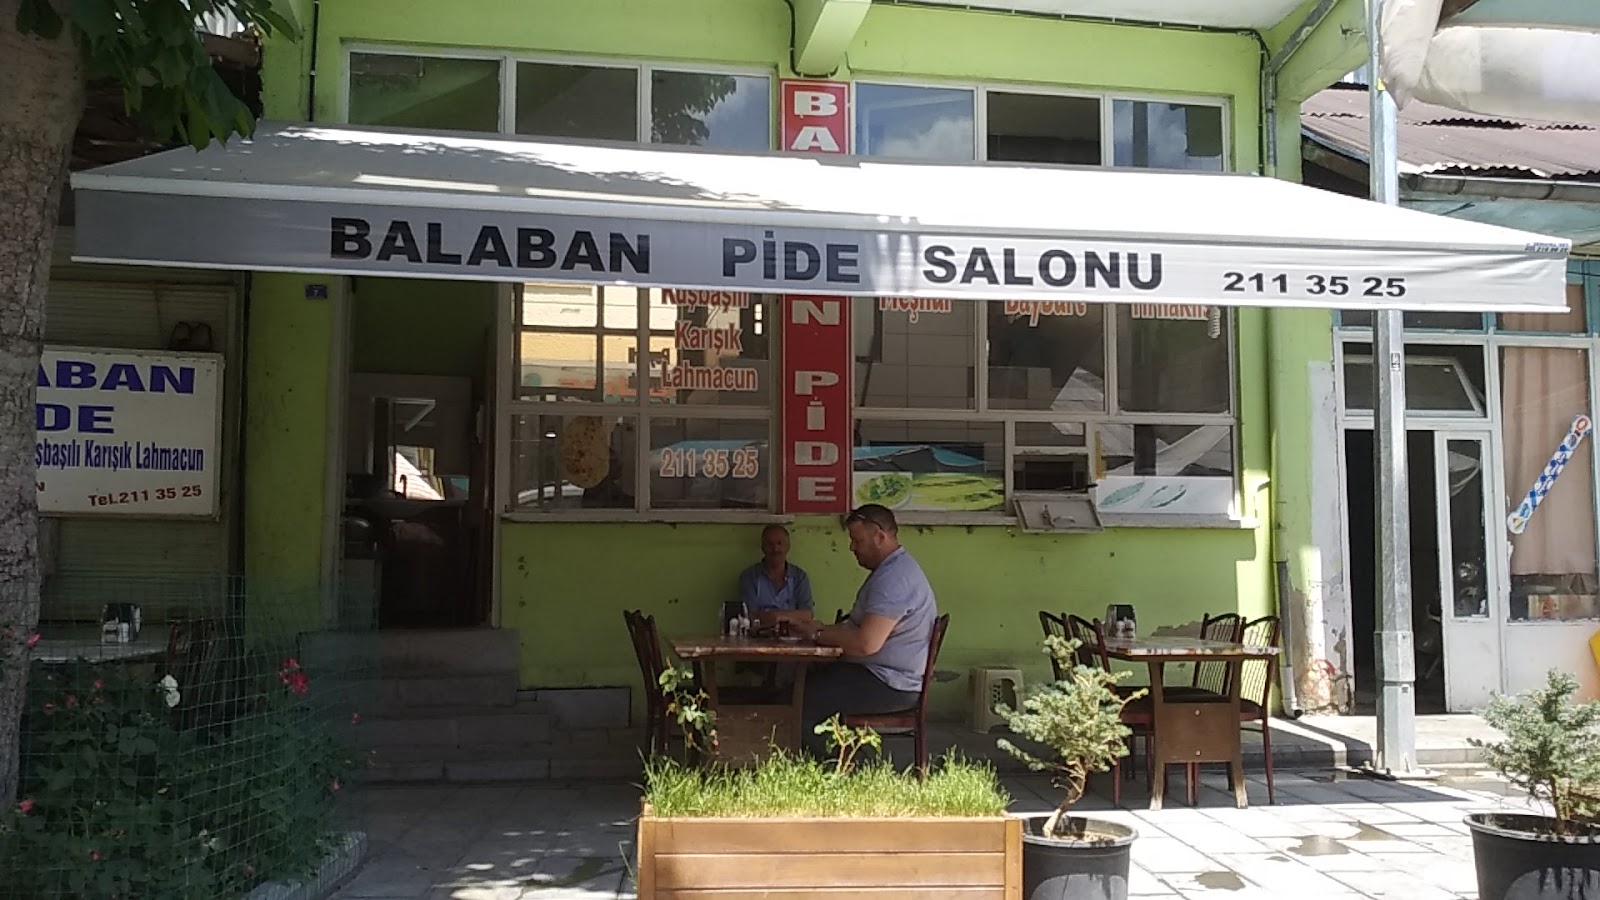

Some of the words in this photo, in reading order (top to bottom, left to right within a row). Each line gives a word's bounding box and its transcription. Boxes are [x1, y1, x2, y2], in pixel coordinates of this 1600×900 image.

[329, 217, 650, 274] BALABAN
[722, 230, 860, 283] PİDE
[922, 244, 1163, 290] SALONU
[1223, 271, 1290, 294] 211
[1306, 274, 1350, 296] 35
[1362, 277, 1407, 298] 25
[675, 320, 743, 355] Karışık
[661, 360, 758, 391] Lahmacun
[794, 371, 840, 501] PİDE
[84, 440, 132, 472] Karışık
[136, 441, 204, 472] Lahmacun
[660, 448, 697, 478] 211
[703, 448, 730, 478] 35
[733, 448, 759, 478] 25
[156, 487, 177, 500] 35
[181, 485, 203, 498] 25
